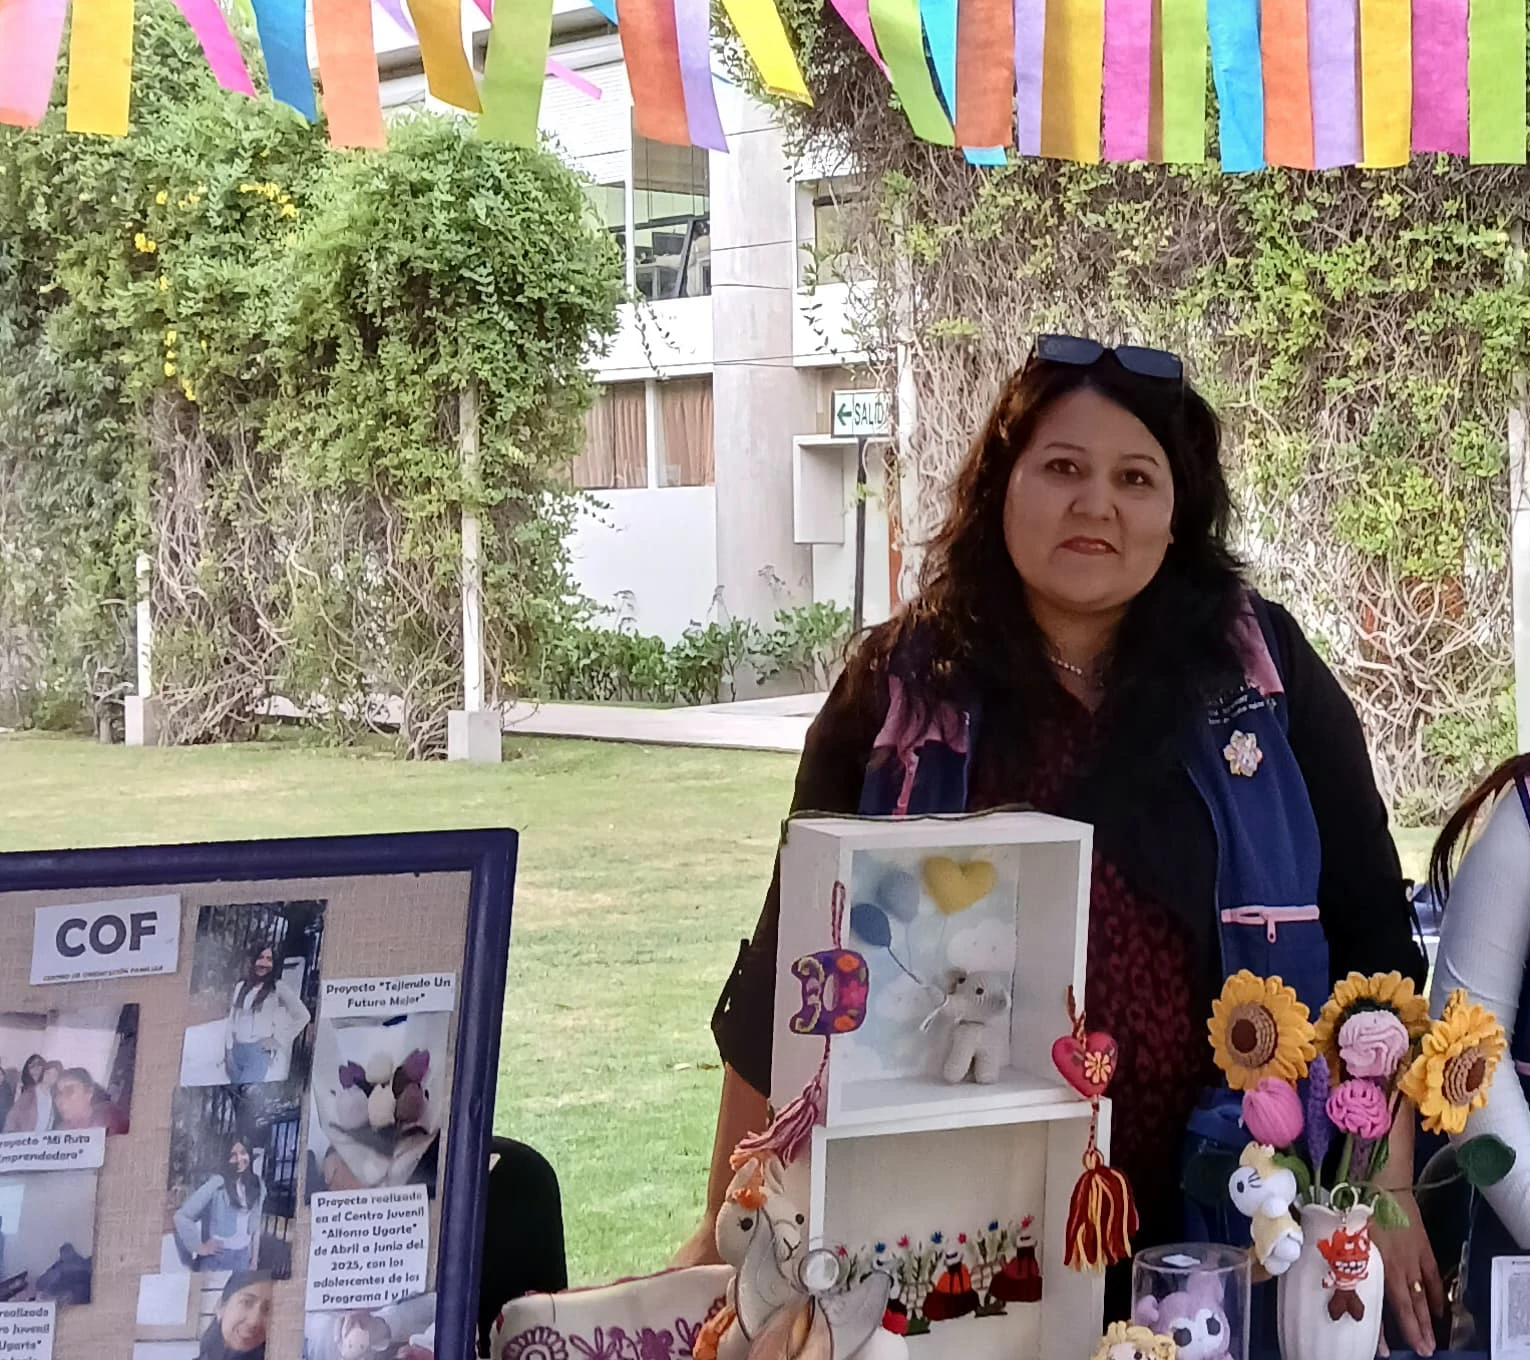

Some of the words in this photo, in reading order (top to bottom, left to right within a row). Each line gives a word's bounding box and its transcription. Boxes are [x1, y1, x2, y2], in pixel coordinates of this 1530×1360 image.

[56, 911, 158, 958] COF
[326, 983, 376, 995] Proyecto
[434, 976, 451, 987] Un
[347, 997, 386, 1008] Futuro
[0, 1136, 39, 1148] oyecto
[0, 1149, 84, 1163] mprendedora"
[317, 1196, 367, 1208] Proyecto
[315, 1215, 328, 1224] en
[331, 1212, 341, 1222] el
[344, 1211, 383, 1221] Centro
[387, 1206, 424, 1220] Juvenil
[314, 1246, 327, 1256] de
[330, 1243, 359, 1255] Abril
[374, 1242, 403, 1253] Junio
[406, 1239, 424, 1250] del
[366, 1260, 385, 1269] con
[389, 1257, 404, 1267] los
[313, 1275, 385, 1288] adolescentes
[388, 1273, 402, 1284] de
[405, 1272, 419, 1282] los
[322, 1292, 381, 1304] Programa
